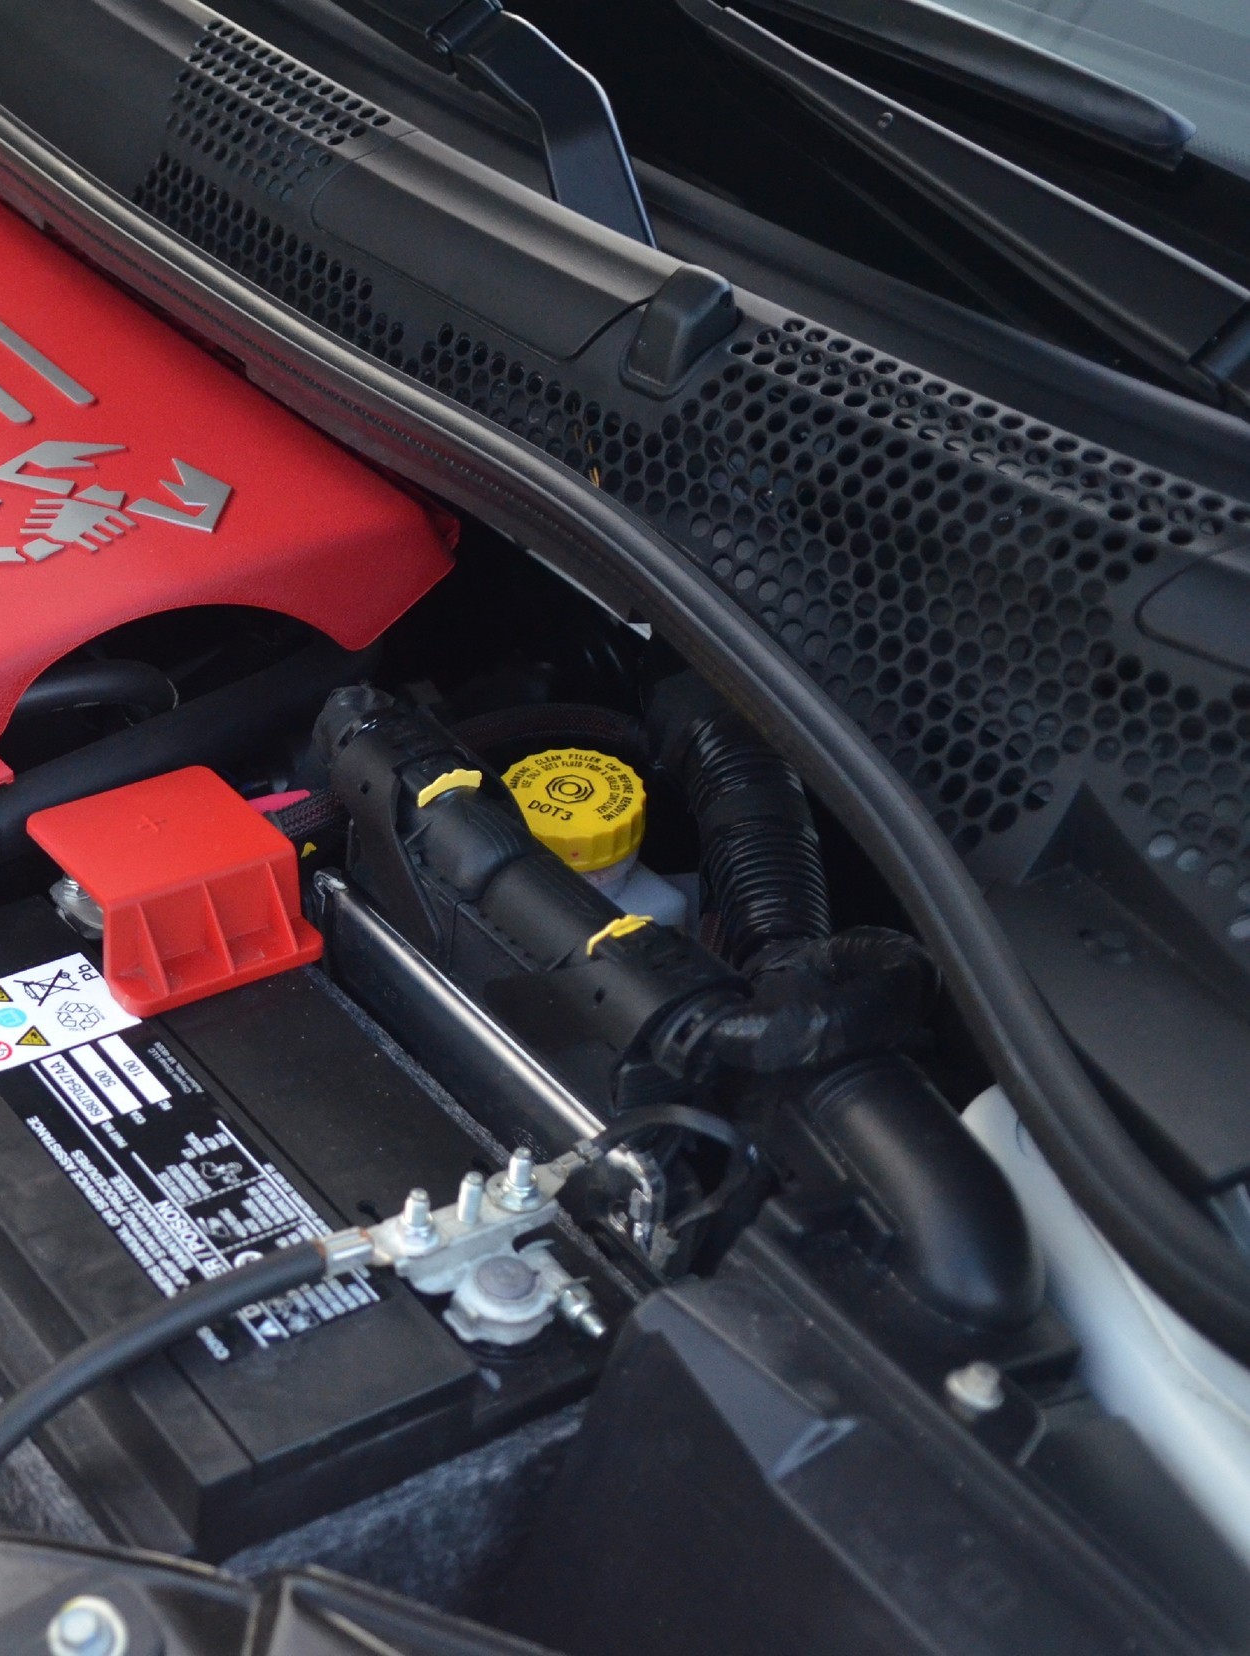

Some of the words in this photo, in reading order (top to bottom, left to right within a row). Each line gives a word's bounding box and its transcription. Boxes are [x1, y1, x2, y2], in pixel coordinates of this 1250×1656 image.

[535, 755, 562, 765] CLEAN
[569, 754, 601, 763] FILLER
[605, 763, 621, 771] CAP
[618, 774, 634, 794] BEFORE
[528, 800, 575, 821] DOT3
[78, 964, 100, 982] Pb
[95, 1070, 116, 1088] 500
[123, 1059, 145, 1077] 100
[48, 1060, 104, 1118] 68070547AA
[26, 1115, 78, 1172] ASSISTANCE
[70, 1170, 109, 1211] SERVICE
[71, 1149, 129, 1212] PROCEDURES
[109, 1174, 139, 1202] FREE
[101, 1210, 121, 1227] OR
[121, 1211, 168, 1259] STARTING
[128, 1200, 194, 1270] MAINTENANCE
[156, 1200, 207, 1252] POISON
[115, 1226, 156, 1268] MANUAL
